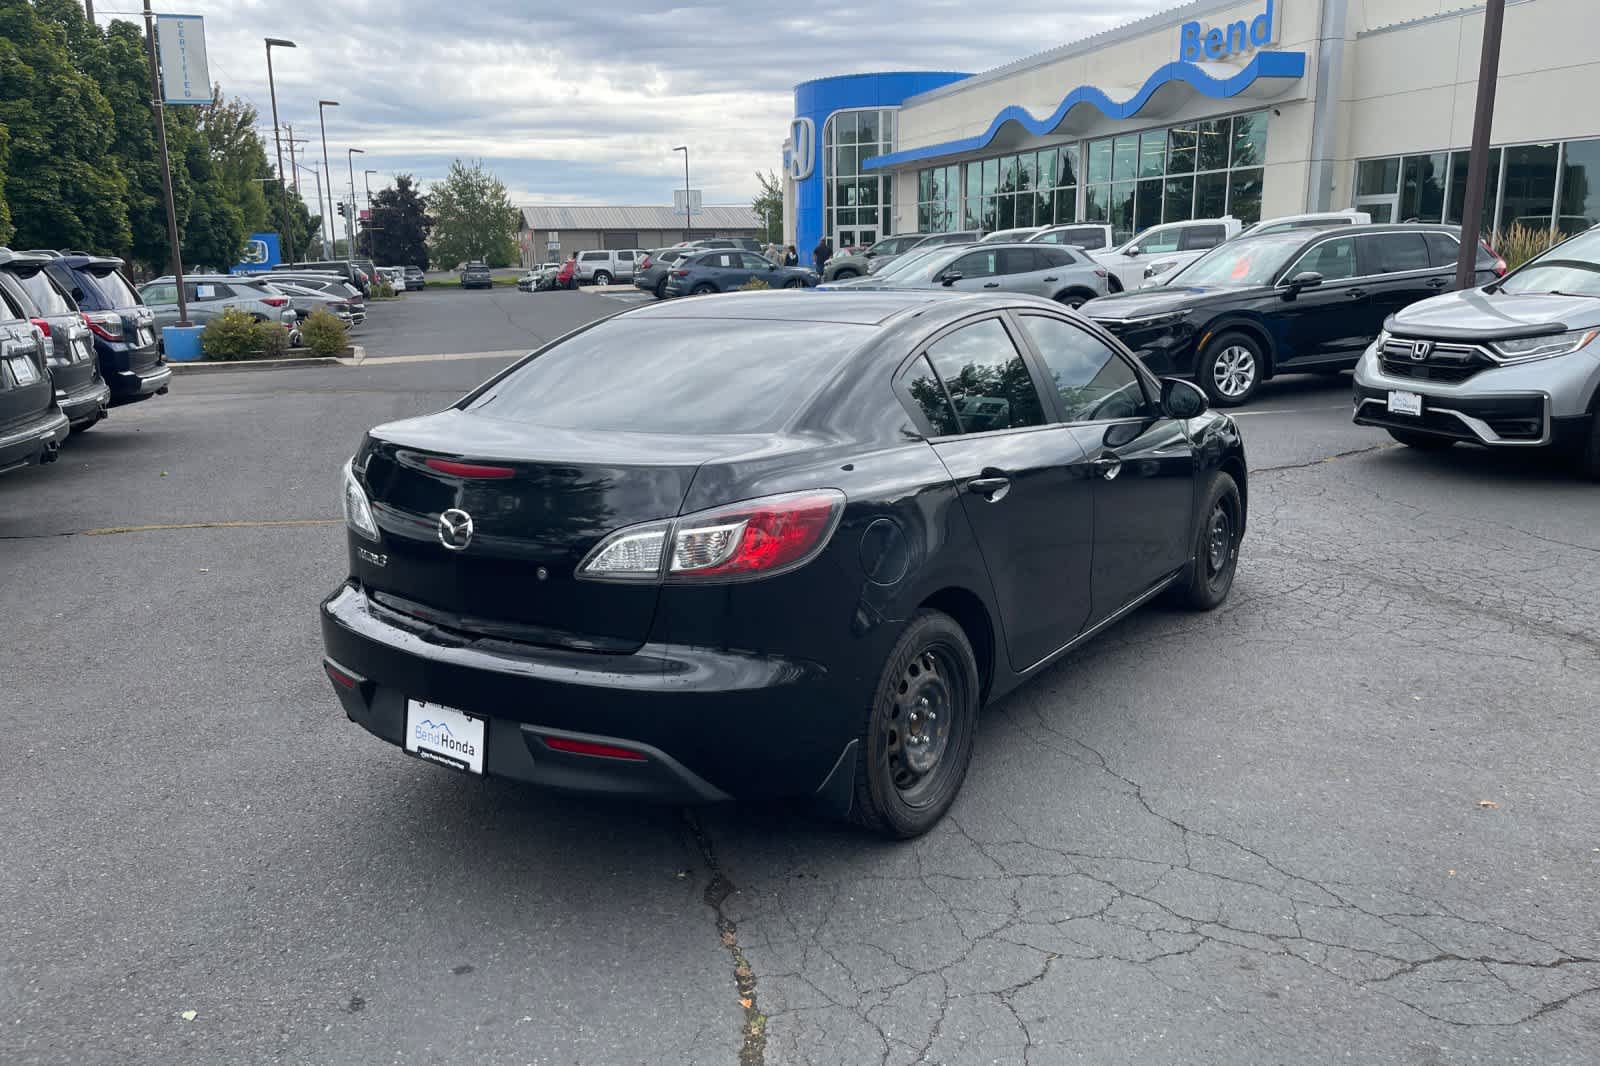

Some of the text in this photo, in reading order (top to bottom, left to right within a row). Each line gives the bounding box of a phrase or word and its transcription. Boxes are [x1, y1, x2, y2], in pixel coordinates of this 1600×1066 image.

[177, 21, 192, 97] CERTIFIED
[1180, 0, 1273, 63] Bend
[416, 725, 475, 756] Bend Honda
